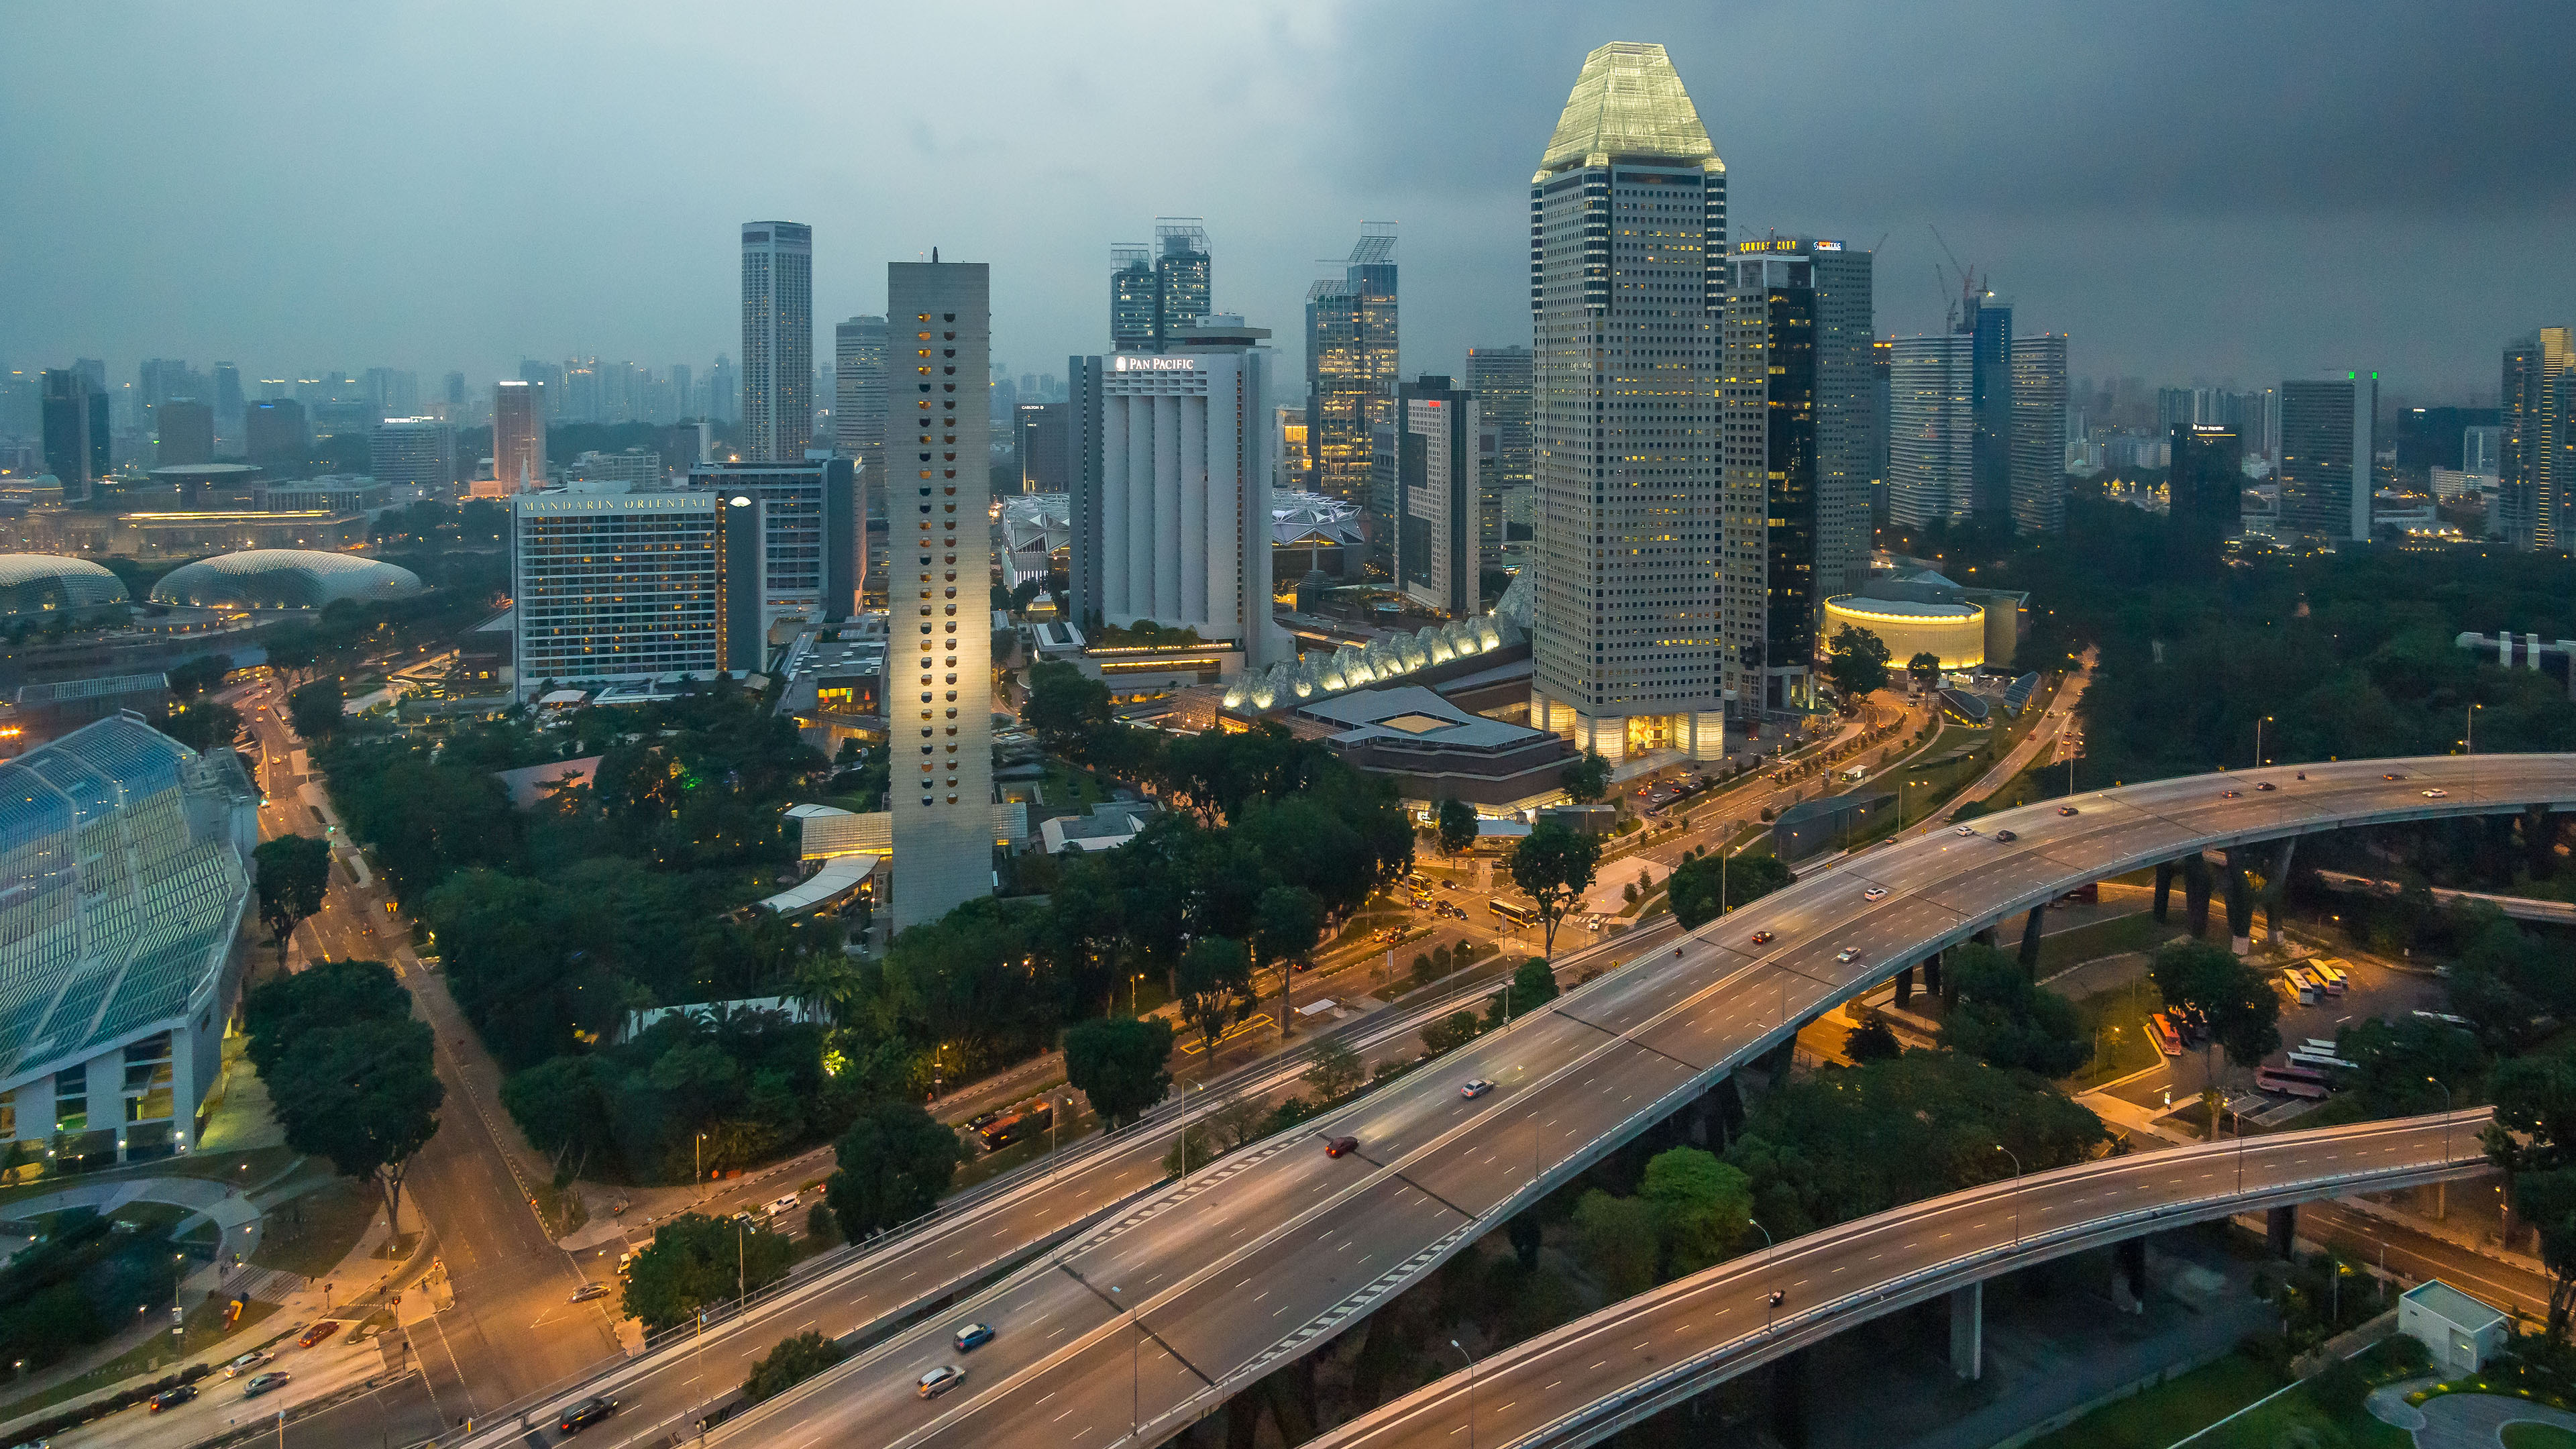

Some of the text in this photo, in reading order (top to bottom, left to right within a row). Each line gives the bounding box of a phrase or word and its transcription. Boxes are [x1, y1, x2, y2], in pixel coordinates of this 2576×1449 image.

[1777, 241, 1796, 250] CITY
[1130, 358, 1194, 370] PAN PACIFIC
[525, 498, 708, 511] MANDARIN ORIENTAL
